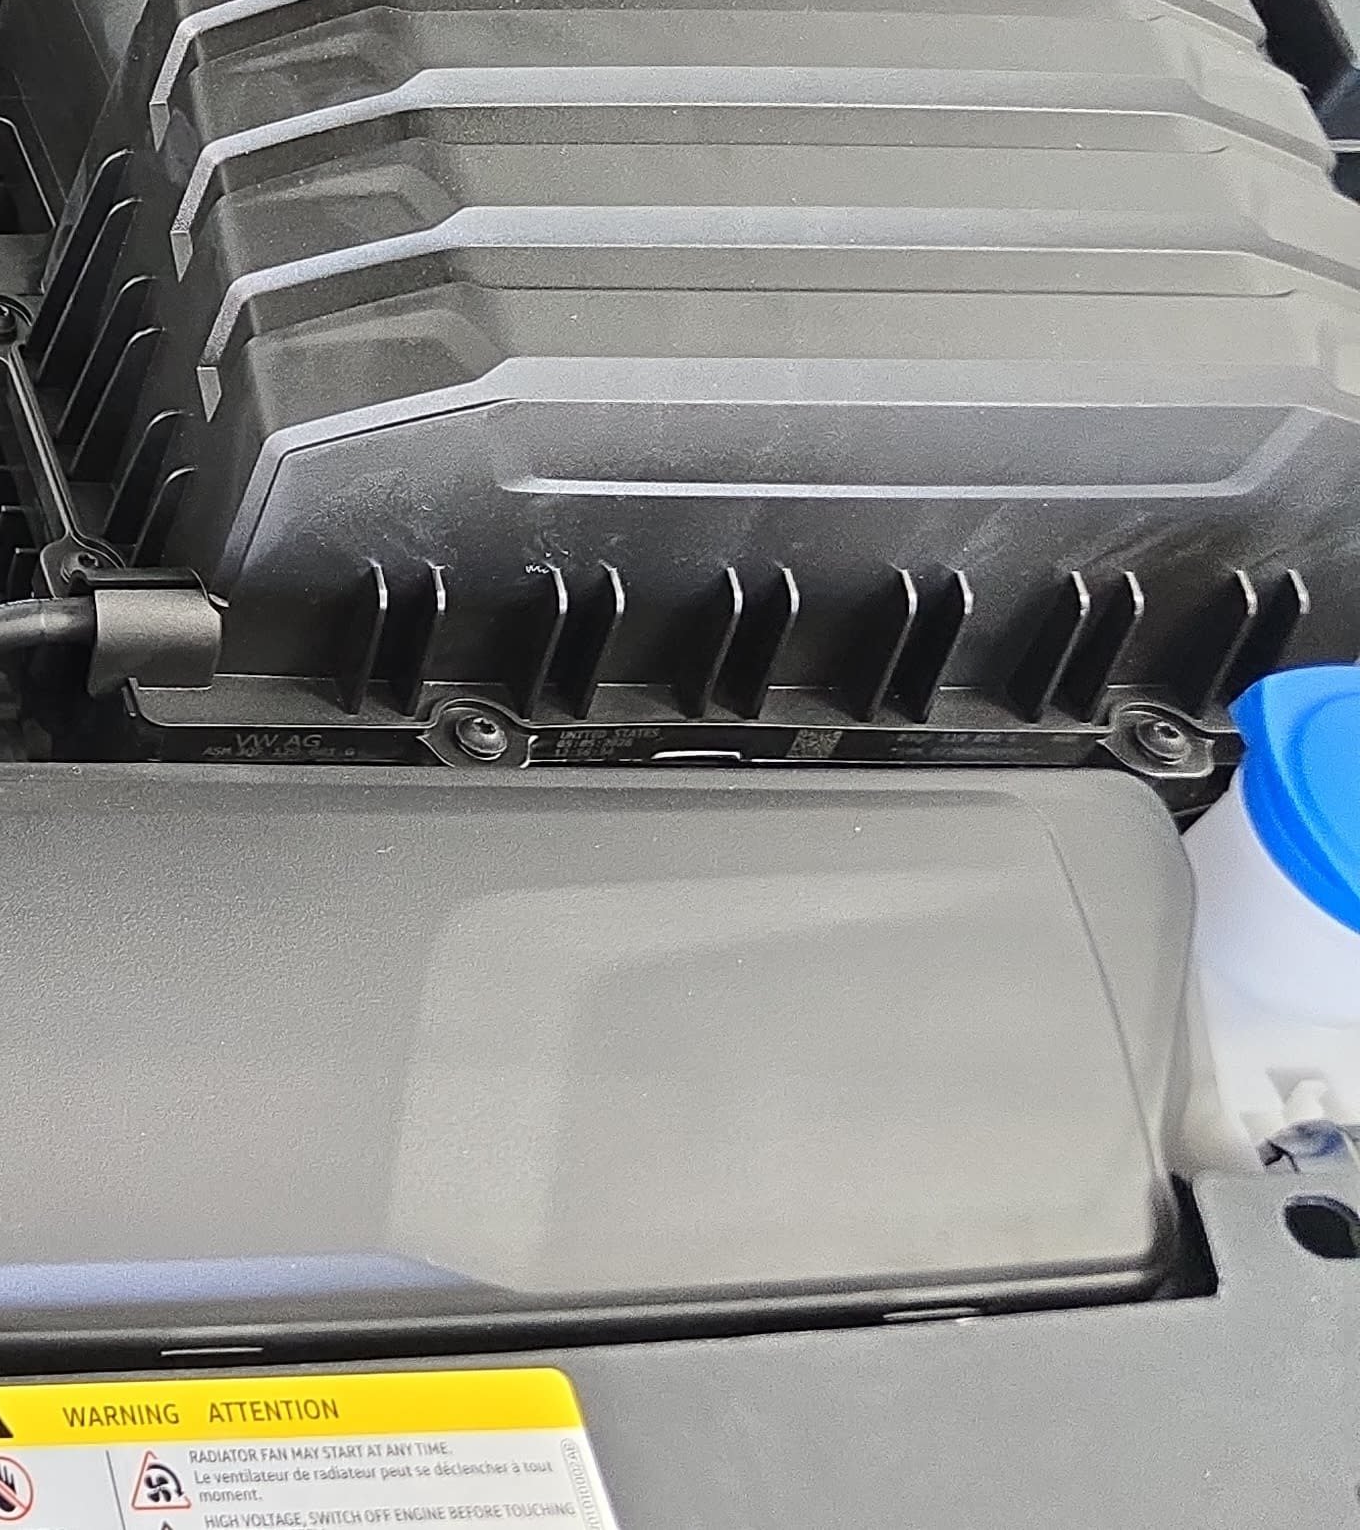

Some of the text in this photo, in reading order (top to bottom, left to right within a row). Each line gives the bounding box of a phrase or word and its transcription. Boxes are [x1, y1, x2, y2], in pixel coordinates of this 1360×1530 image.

[234, 733, 323, 747] VW AG
[62, 1399, 340, 1429] WARNING ATTENTION
[189, 1449, 256, 1464] RADIATOR
[261, 1447, 288, 1462] FAN
[291, 1446, 318, 1461] MAY
[322, 1445, 363, 1460] START
[367, 1445, 382, 1459] AT
[386, 1444, 414, 1458] ANY
[195, 1470, 209, 1484] Le
[213, 1468, 289, 1484] ventilateur
[292, 1467, 310, 1482] de
[314, 1466, 376, 1481] radiateur
[380, 1466, 411, 1482] peut
[414, 1468, 431, 1478] se
[524, 1461, 552, 1474] tout
[199, 1489, 262, 1504] moment.
[205, 1514, 239, 1530] HIGH
[309, 1510, 360, 1526] SWITCH
[364, 1509, 391, 1523] OFF
[395, 1506, 446, 1522] ENGINE
[449, 1505, 501, 1519] BEFORE
[505, 1502, 576, 1518] TOUCHING
